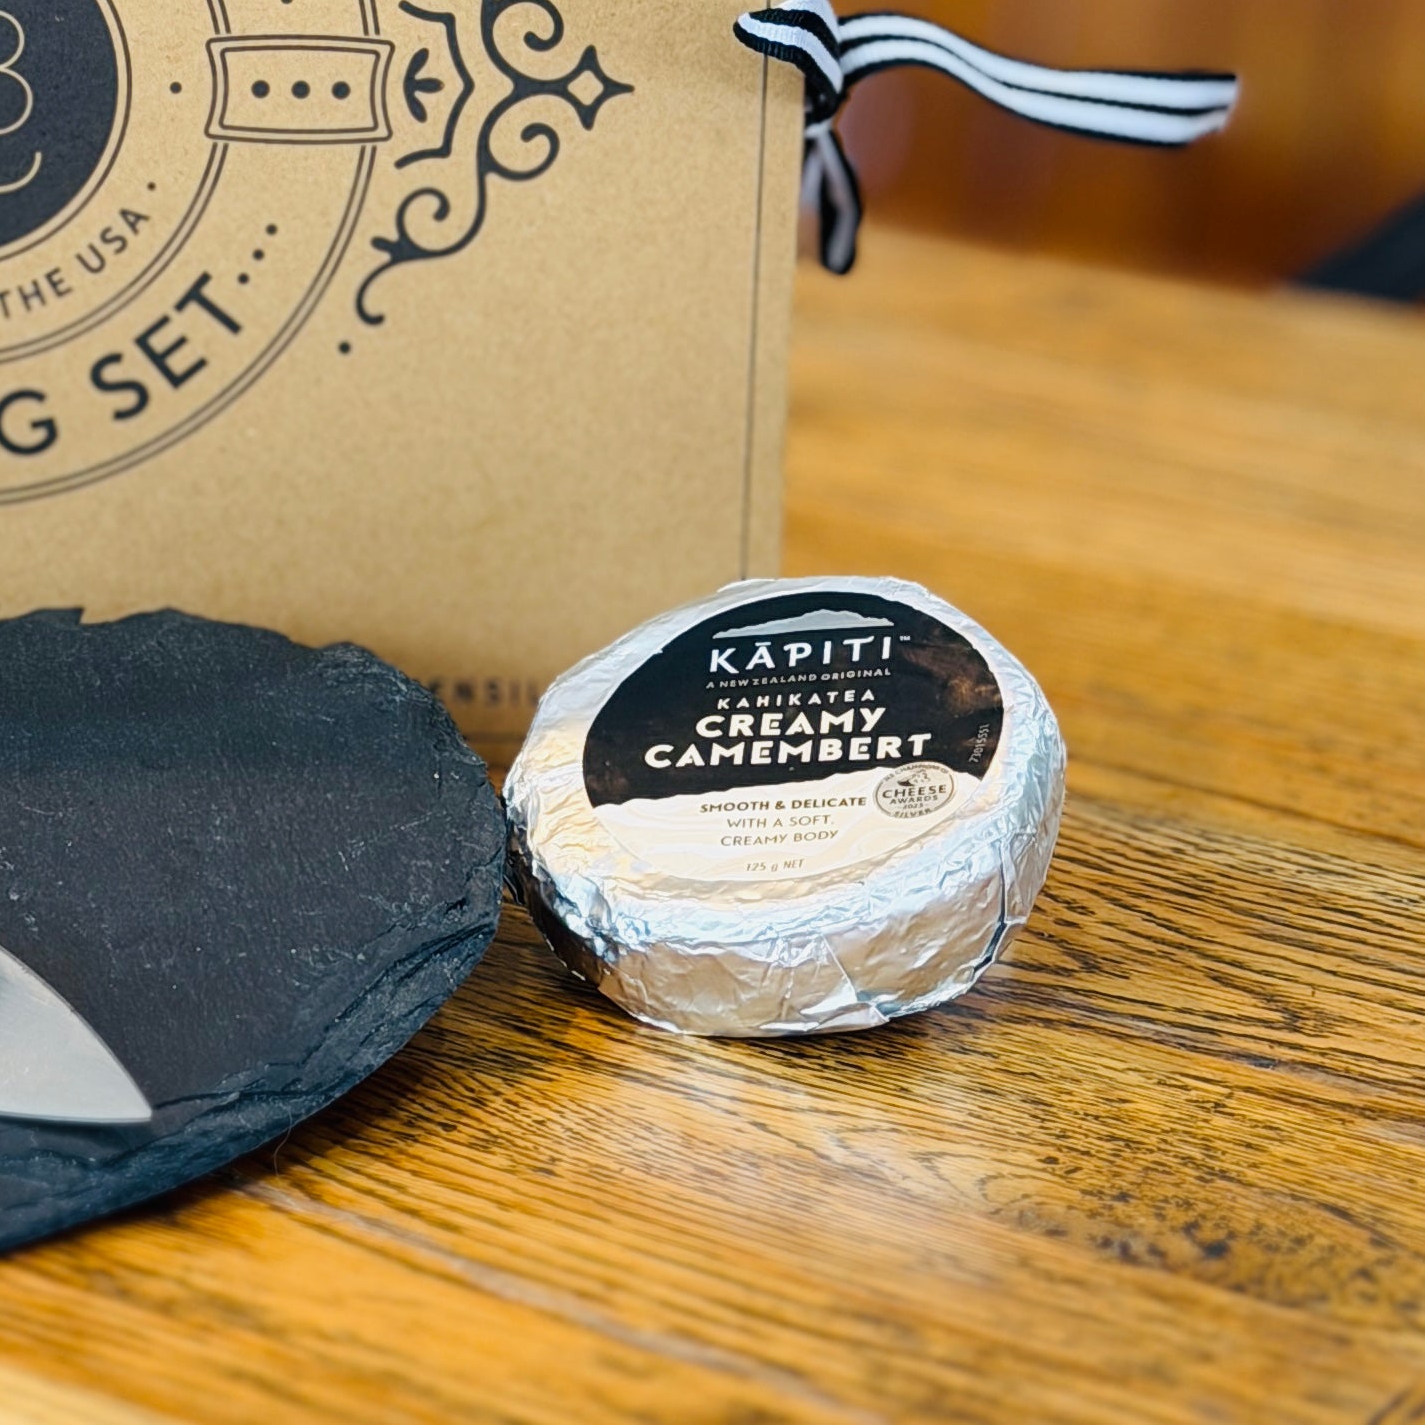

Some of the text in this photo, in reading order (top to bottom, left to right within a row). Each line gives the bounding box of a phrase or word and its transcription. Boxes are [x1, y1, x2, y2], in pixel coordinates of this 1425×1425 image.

[75, 208, 150, 274] USA
[90, 272, 242, 421] SET
[706, 667, 892, 689] A NEW ZEALAND ORIGINAL
[717, 689, 875, 710] KAHIKATEA
[695, 707, 887, 738] CREAMY
[644, 733, 932, 768] CAMEMBERT
[882, 784, 947, 799] CHEESE
[889, 795, 938, 805] AWARDS
[699, 797, 867, 813] SMOOTH & DELICATE
[894, 808, 932, 819] SILVER
[727, 817, 767, 829] WITH
[772, 817, 783, 828] A
[720, 829, 839, 847] CREAMY BODY
[746, 861, 767, 872] 125
[782, 857, 806, 870] NET
